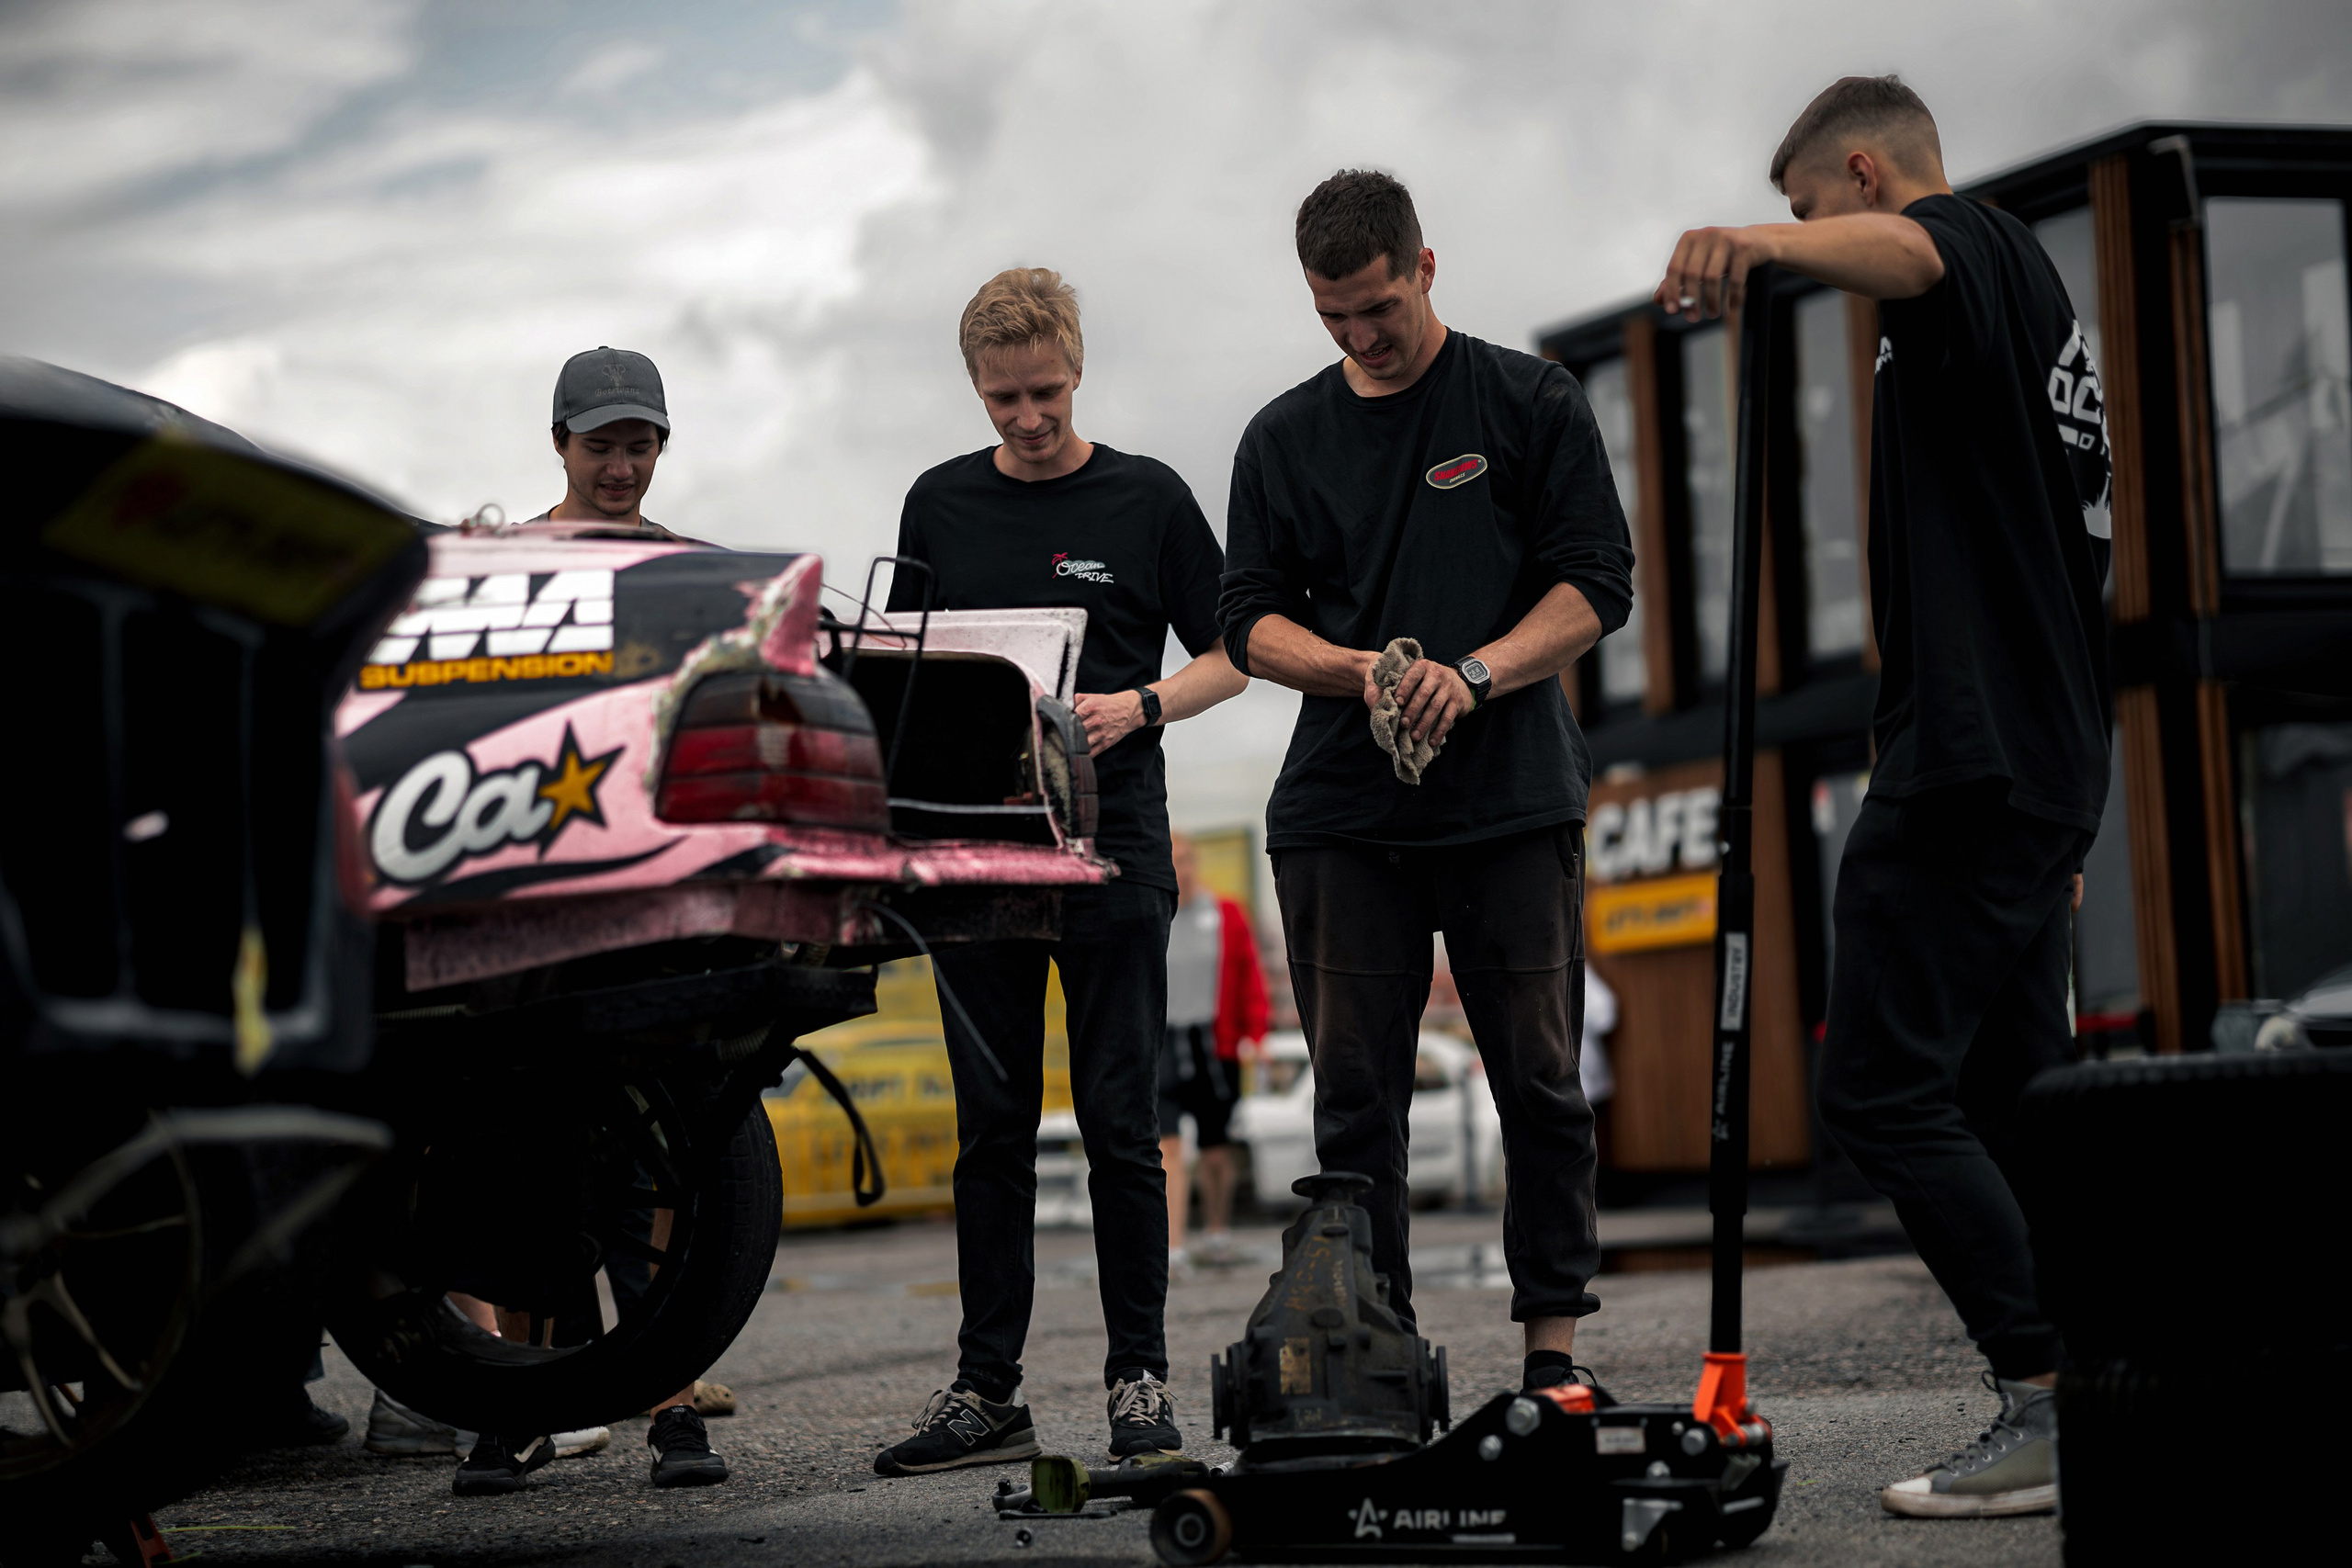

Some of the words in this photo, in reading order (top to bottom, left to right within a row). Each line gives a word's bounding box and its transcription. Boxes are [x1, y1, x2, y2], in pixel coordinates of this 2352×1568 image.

[594, 387, 640, 396] Botswana
[1056, 561, 1105, 576] Ocean
[1075, 571, 1114, 583] DRIVE
[360, 650, 614, 689] SUSPENSION
